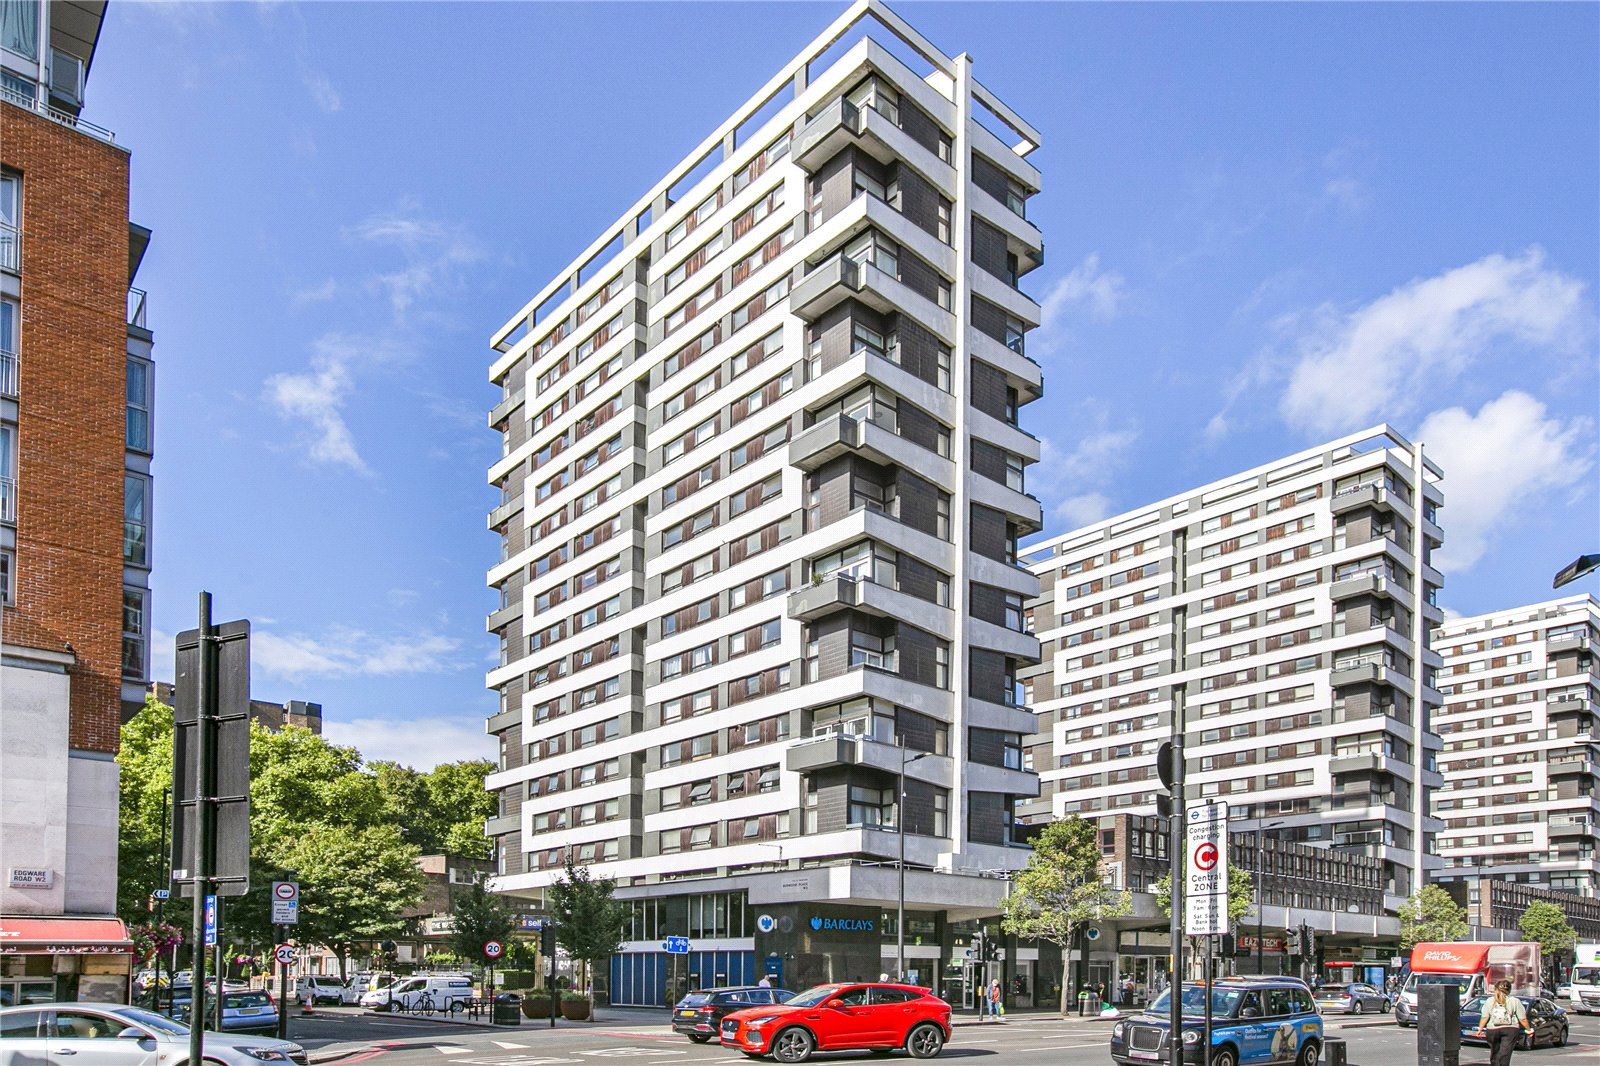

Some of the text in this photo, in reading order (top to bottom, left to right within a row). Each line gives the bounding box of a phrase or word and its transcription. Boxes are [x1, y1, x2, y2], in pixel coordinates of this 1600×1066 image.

[1189, 824, 1225, 834] Congestion
[1193, 832, 1220, 841] charging
[1191, 872, 1222, 882] Central
[1194, 882, 1218, 891] ZONE
[823, 918, 874, 931] BARCLAYS
[1262, 938, 1278, 948] TECH
[278, 949, 294, 959] 20
[487, 945, 500, 953] 20
